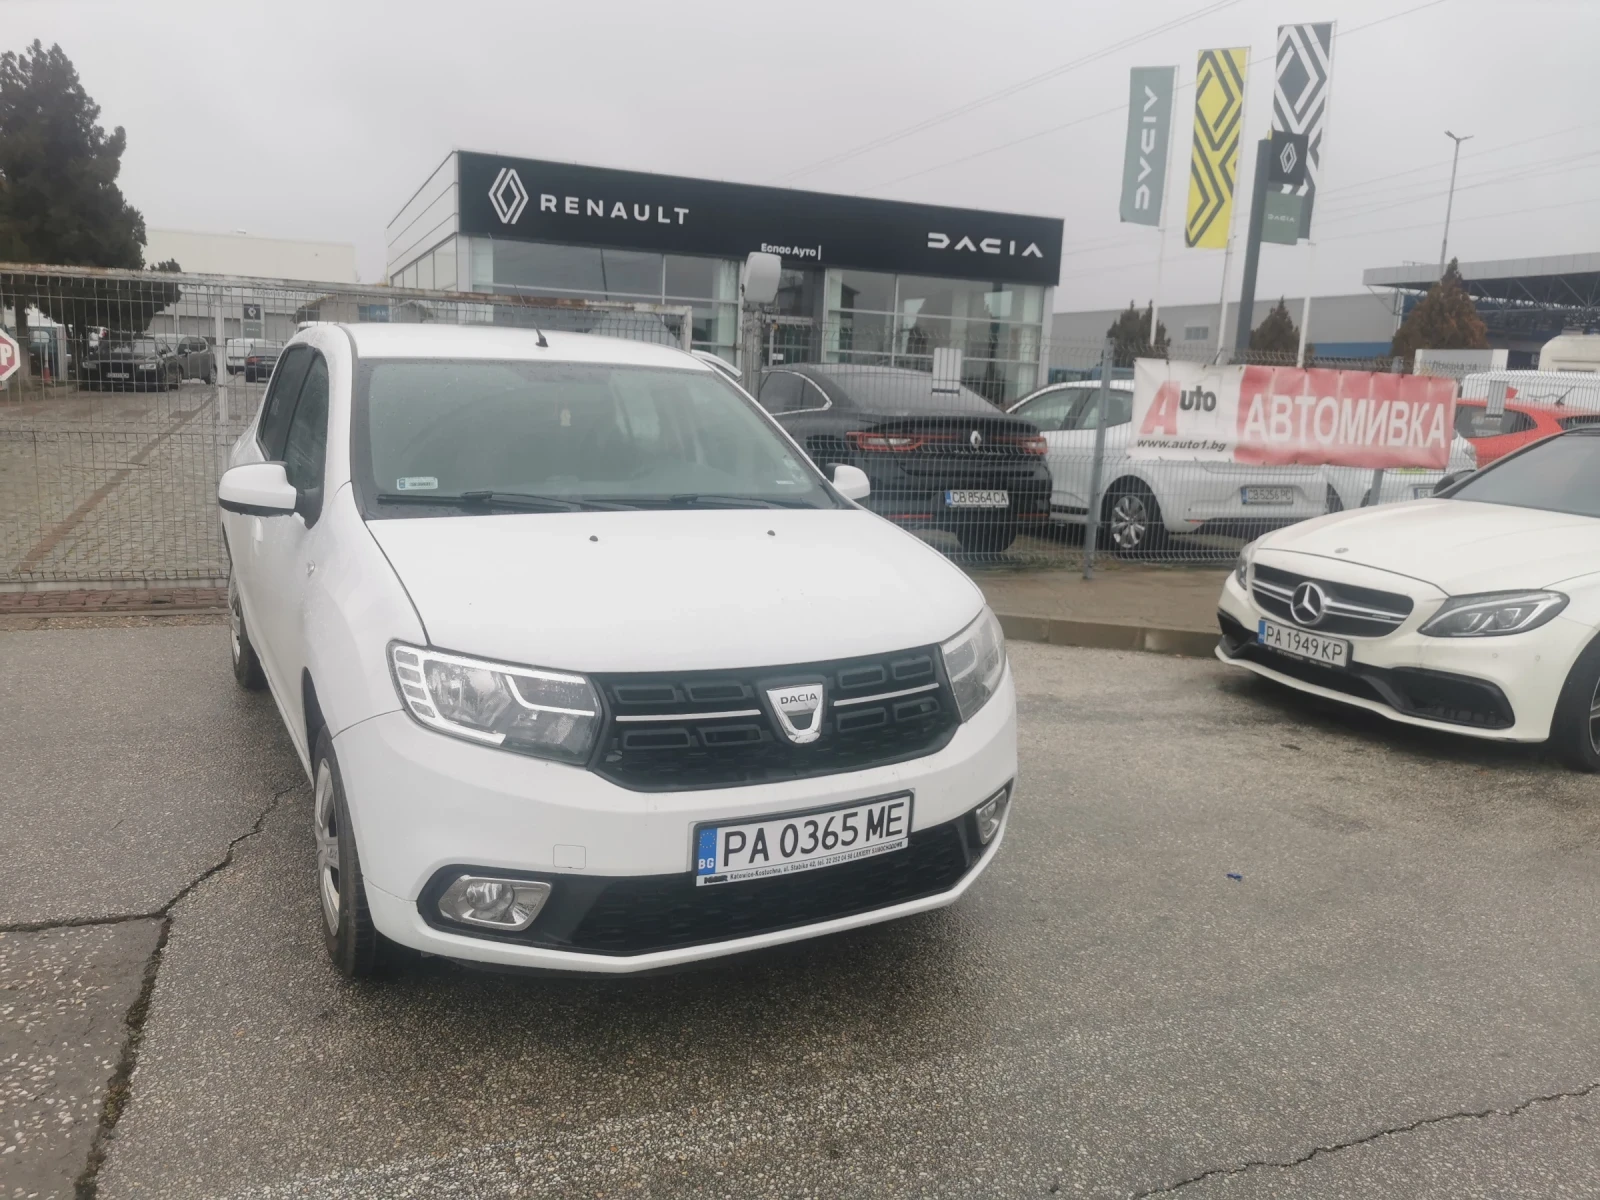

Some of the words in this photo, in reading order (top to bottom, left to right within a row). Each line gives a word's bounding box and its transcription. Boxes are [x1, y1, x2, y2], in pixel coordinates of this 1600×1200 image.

[540, 193, 689, 225] RENAULT
[761, 243, 791, 255] Еспас
[792, 246, 817, 258] Ауто
[927, 232, 1043, 258] DACIA
[1243, 393, 1446, 448] АВТОМИВКА
[1137, 438, 1226, 452] www.auto1.bg
[1266, 626, 1282, 647] PA
[1287, 632, 1319, 656] 1949
[1321, 640, 1343, 661] KP
[780, 693, 818, 704] DACIA
[723, 827, 770, 867] PA
[780, 811, 859, 858] 0365
[865, 801, 905, 842] ME
[698, 857, 714, 870] BG
